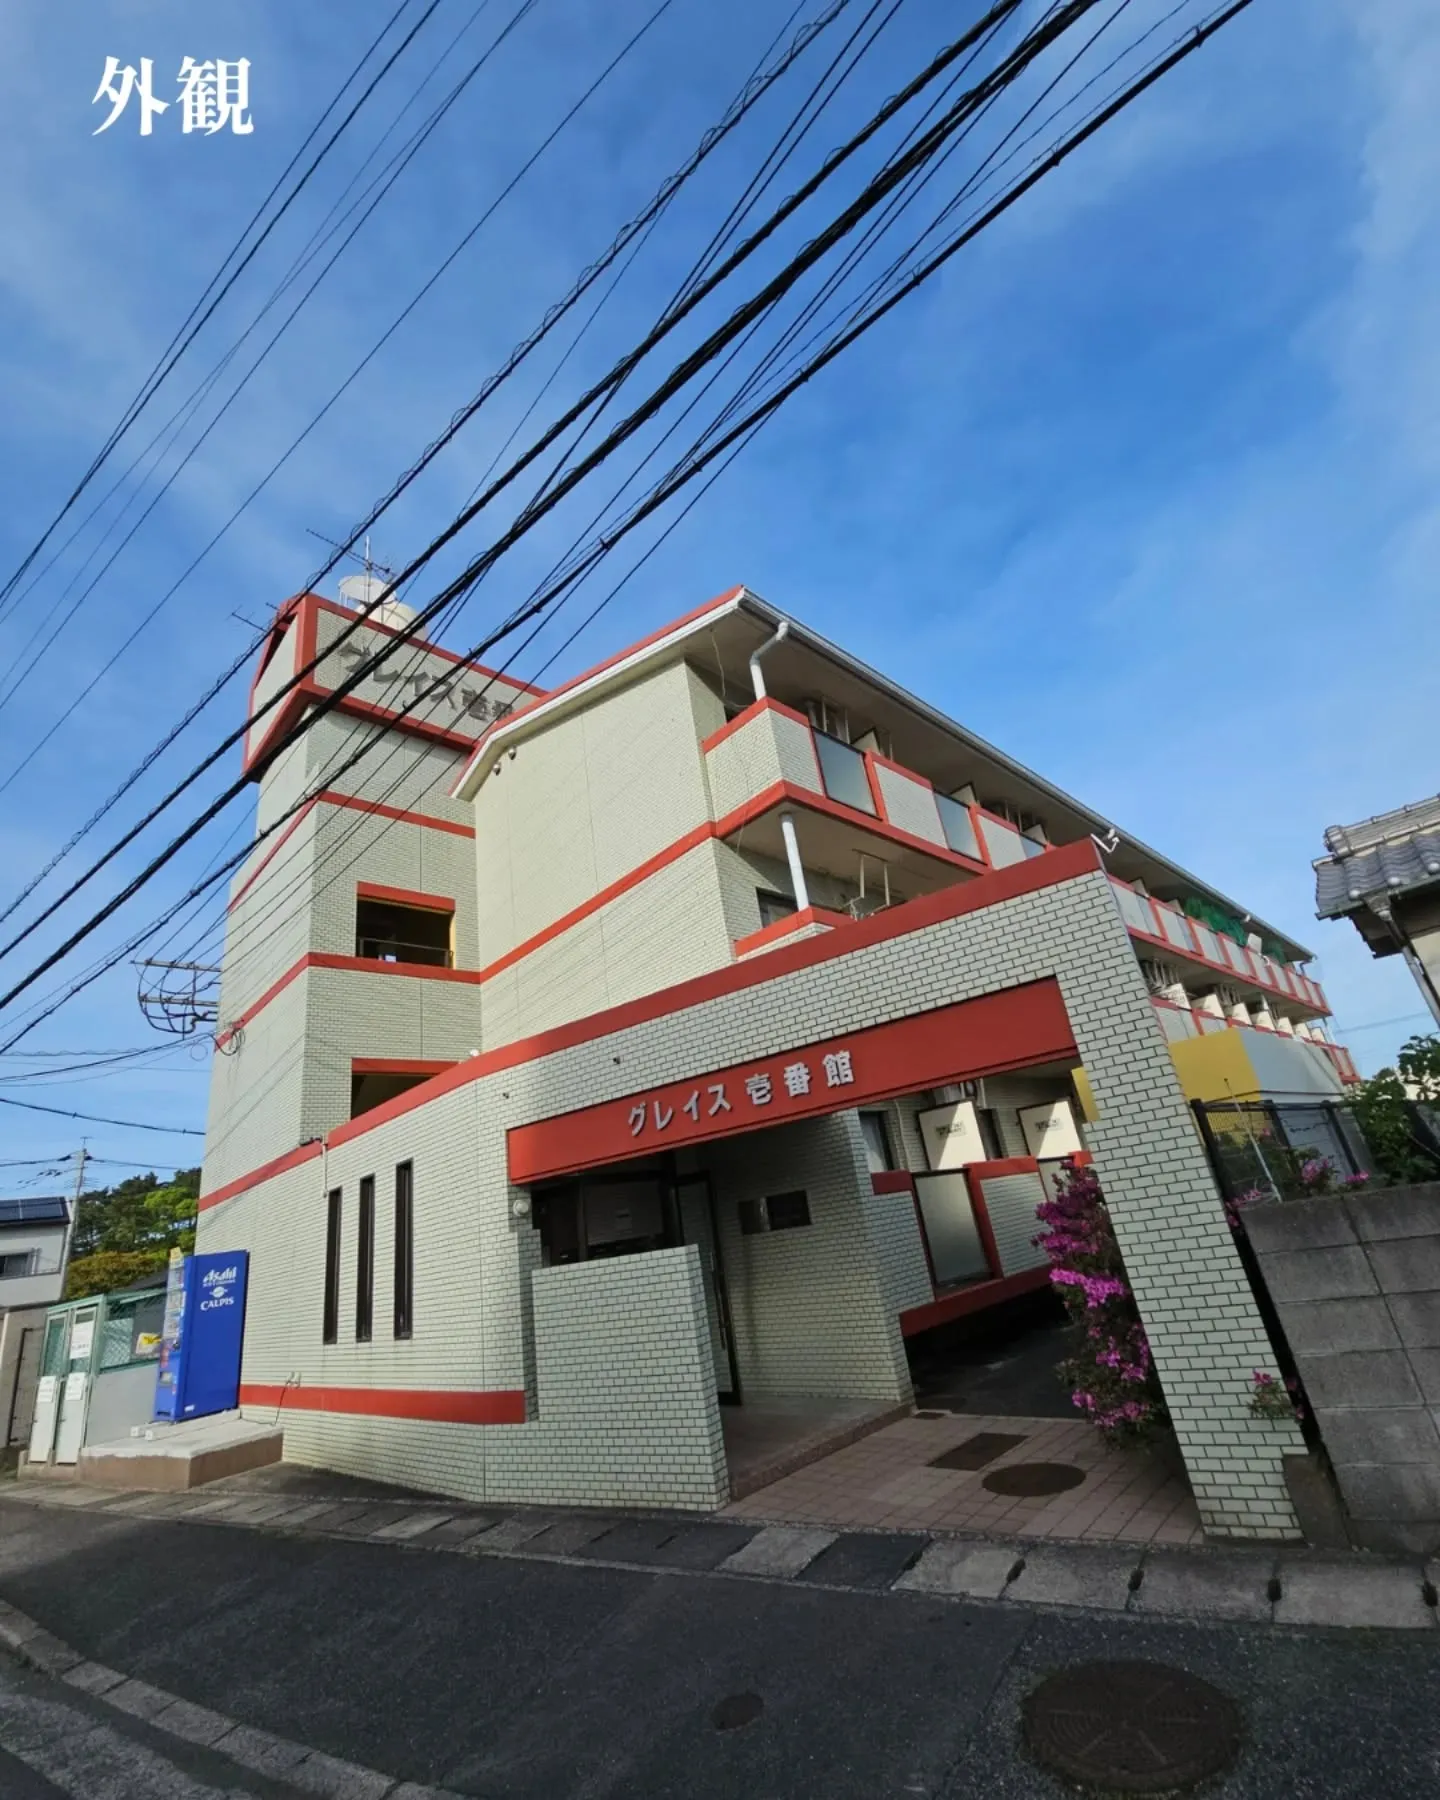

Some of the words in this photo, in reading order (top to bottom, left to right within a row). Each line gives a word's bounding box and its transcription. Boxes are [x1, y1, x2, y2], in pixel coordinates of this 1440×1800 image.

[628, 1051, 854, 1136] グレイス壱番館
[203, 1266, 237, 1282] Asahi
[200, 1297, 234, 1311] CALPIS
